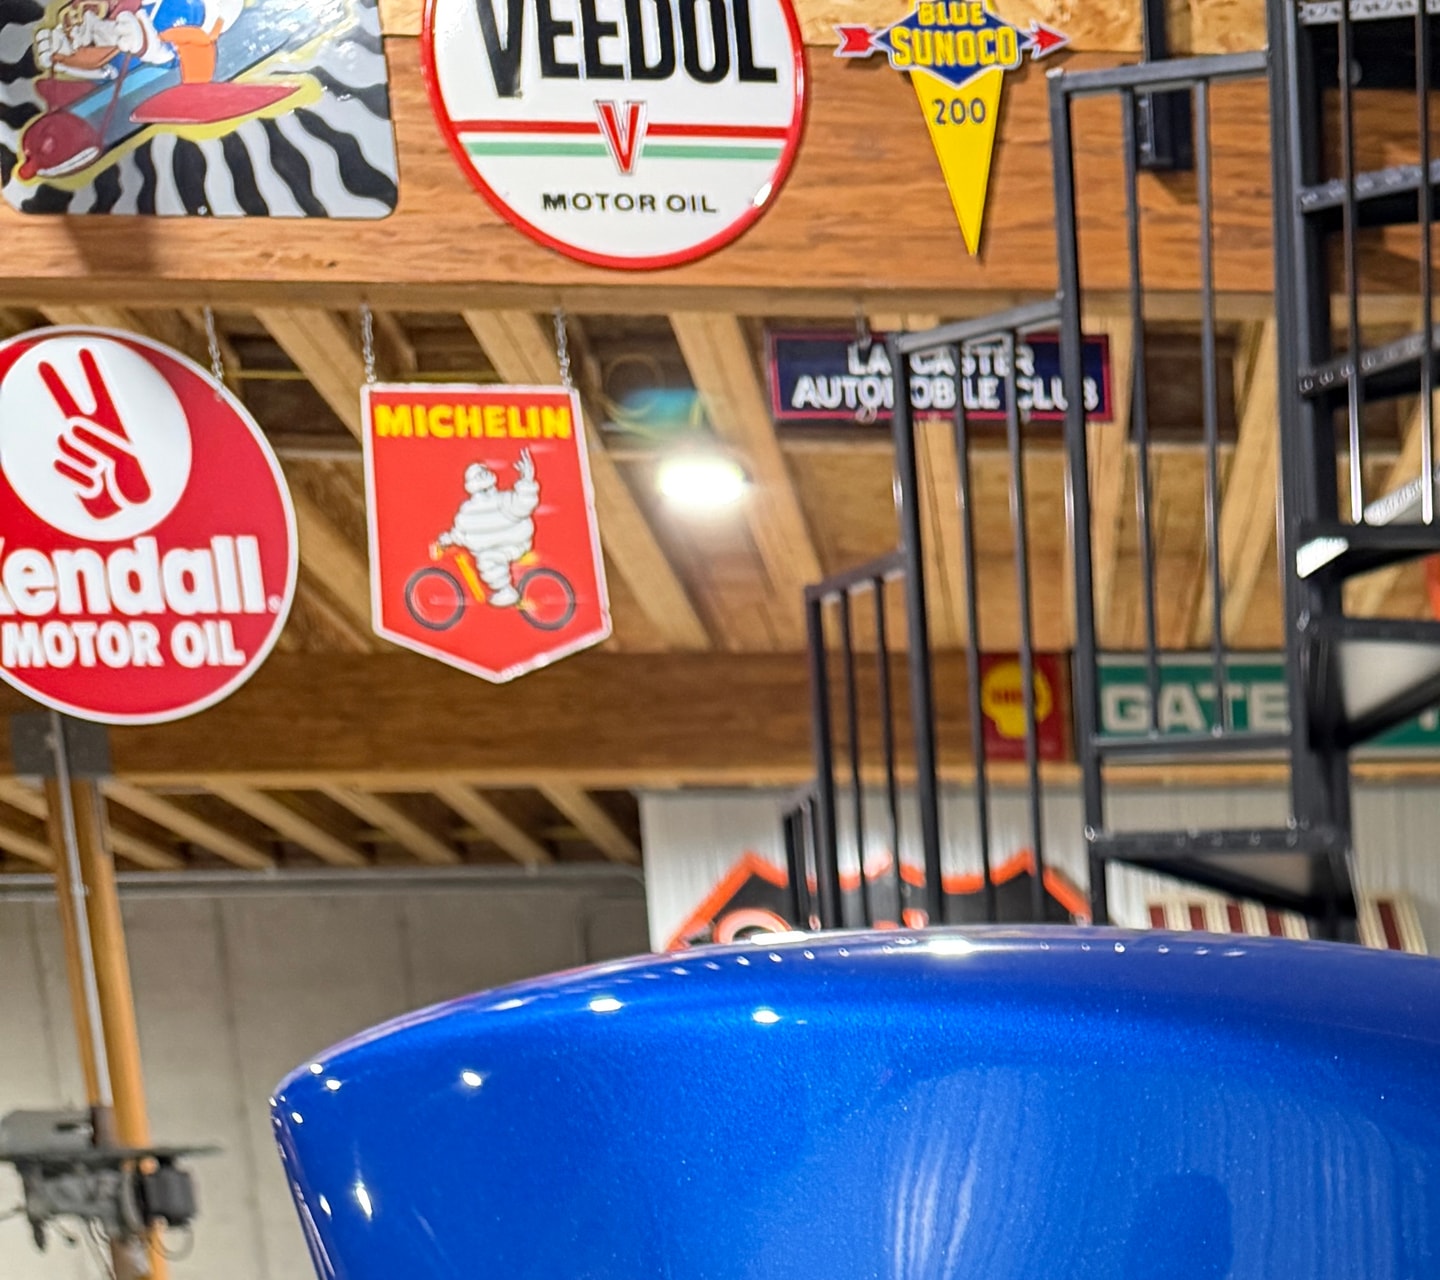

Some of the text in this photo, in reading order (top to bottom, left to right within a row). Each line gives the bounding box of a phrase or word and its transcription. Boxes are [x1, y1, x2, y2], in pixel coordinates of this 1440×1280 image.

[917, 0, 986, 26] BLUE
[476, 0, 777, 98] VEEDOL
[890, 26, 1017, 67] SUNOCO
[934, 98, 986, 125] 200
[543, 193, 717, 213] MOTOR OIL
[374, 403, 573, 439] MICHELIN
[0, 535, 266, 617] endall
[1, 620, 246, 668] MOTOR OIL
